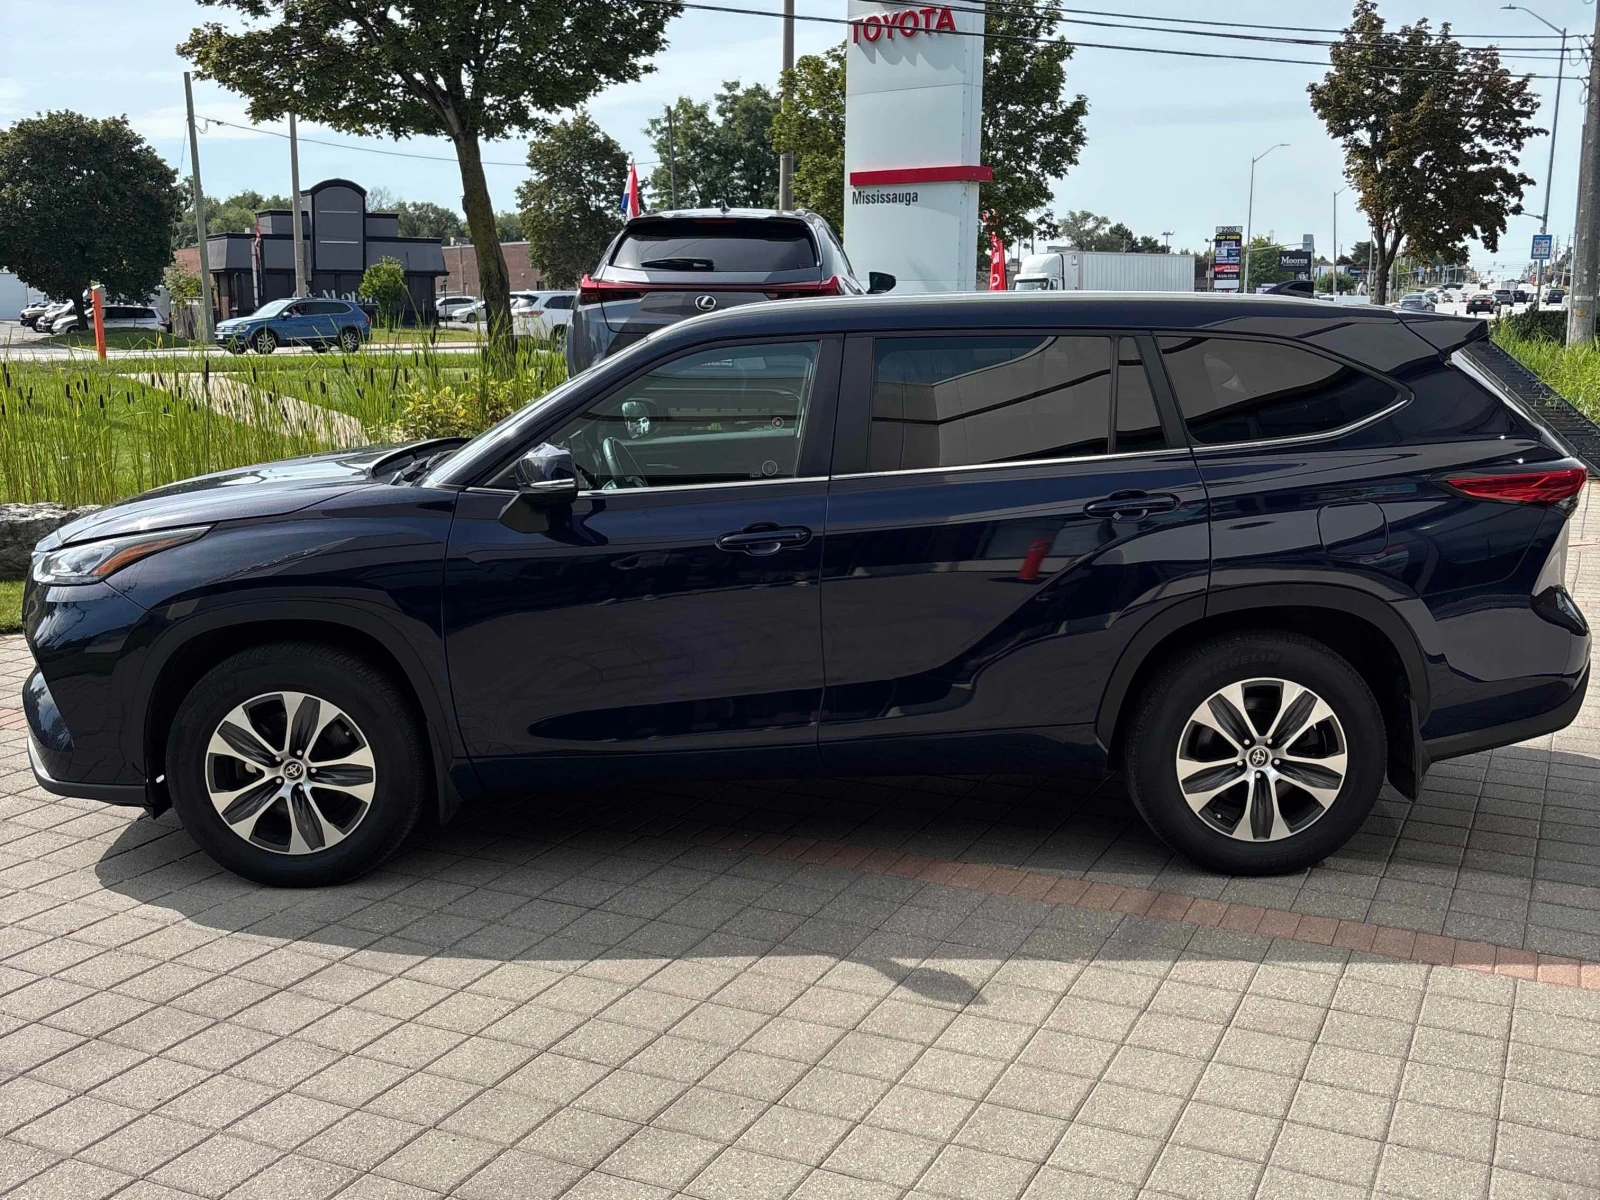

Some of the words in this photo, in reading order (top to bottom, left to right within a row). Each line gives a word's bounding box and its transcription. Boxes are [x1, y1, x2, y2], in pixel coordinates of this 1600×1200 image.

[849, 6, 957, 43] TOYOTA
[852, 190, 918, 206] Mississauga
[1281, 256, 1308, 264] Moores
